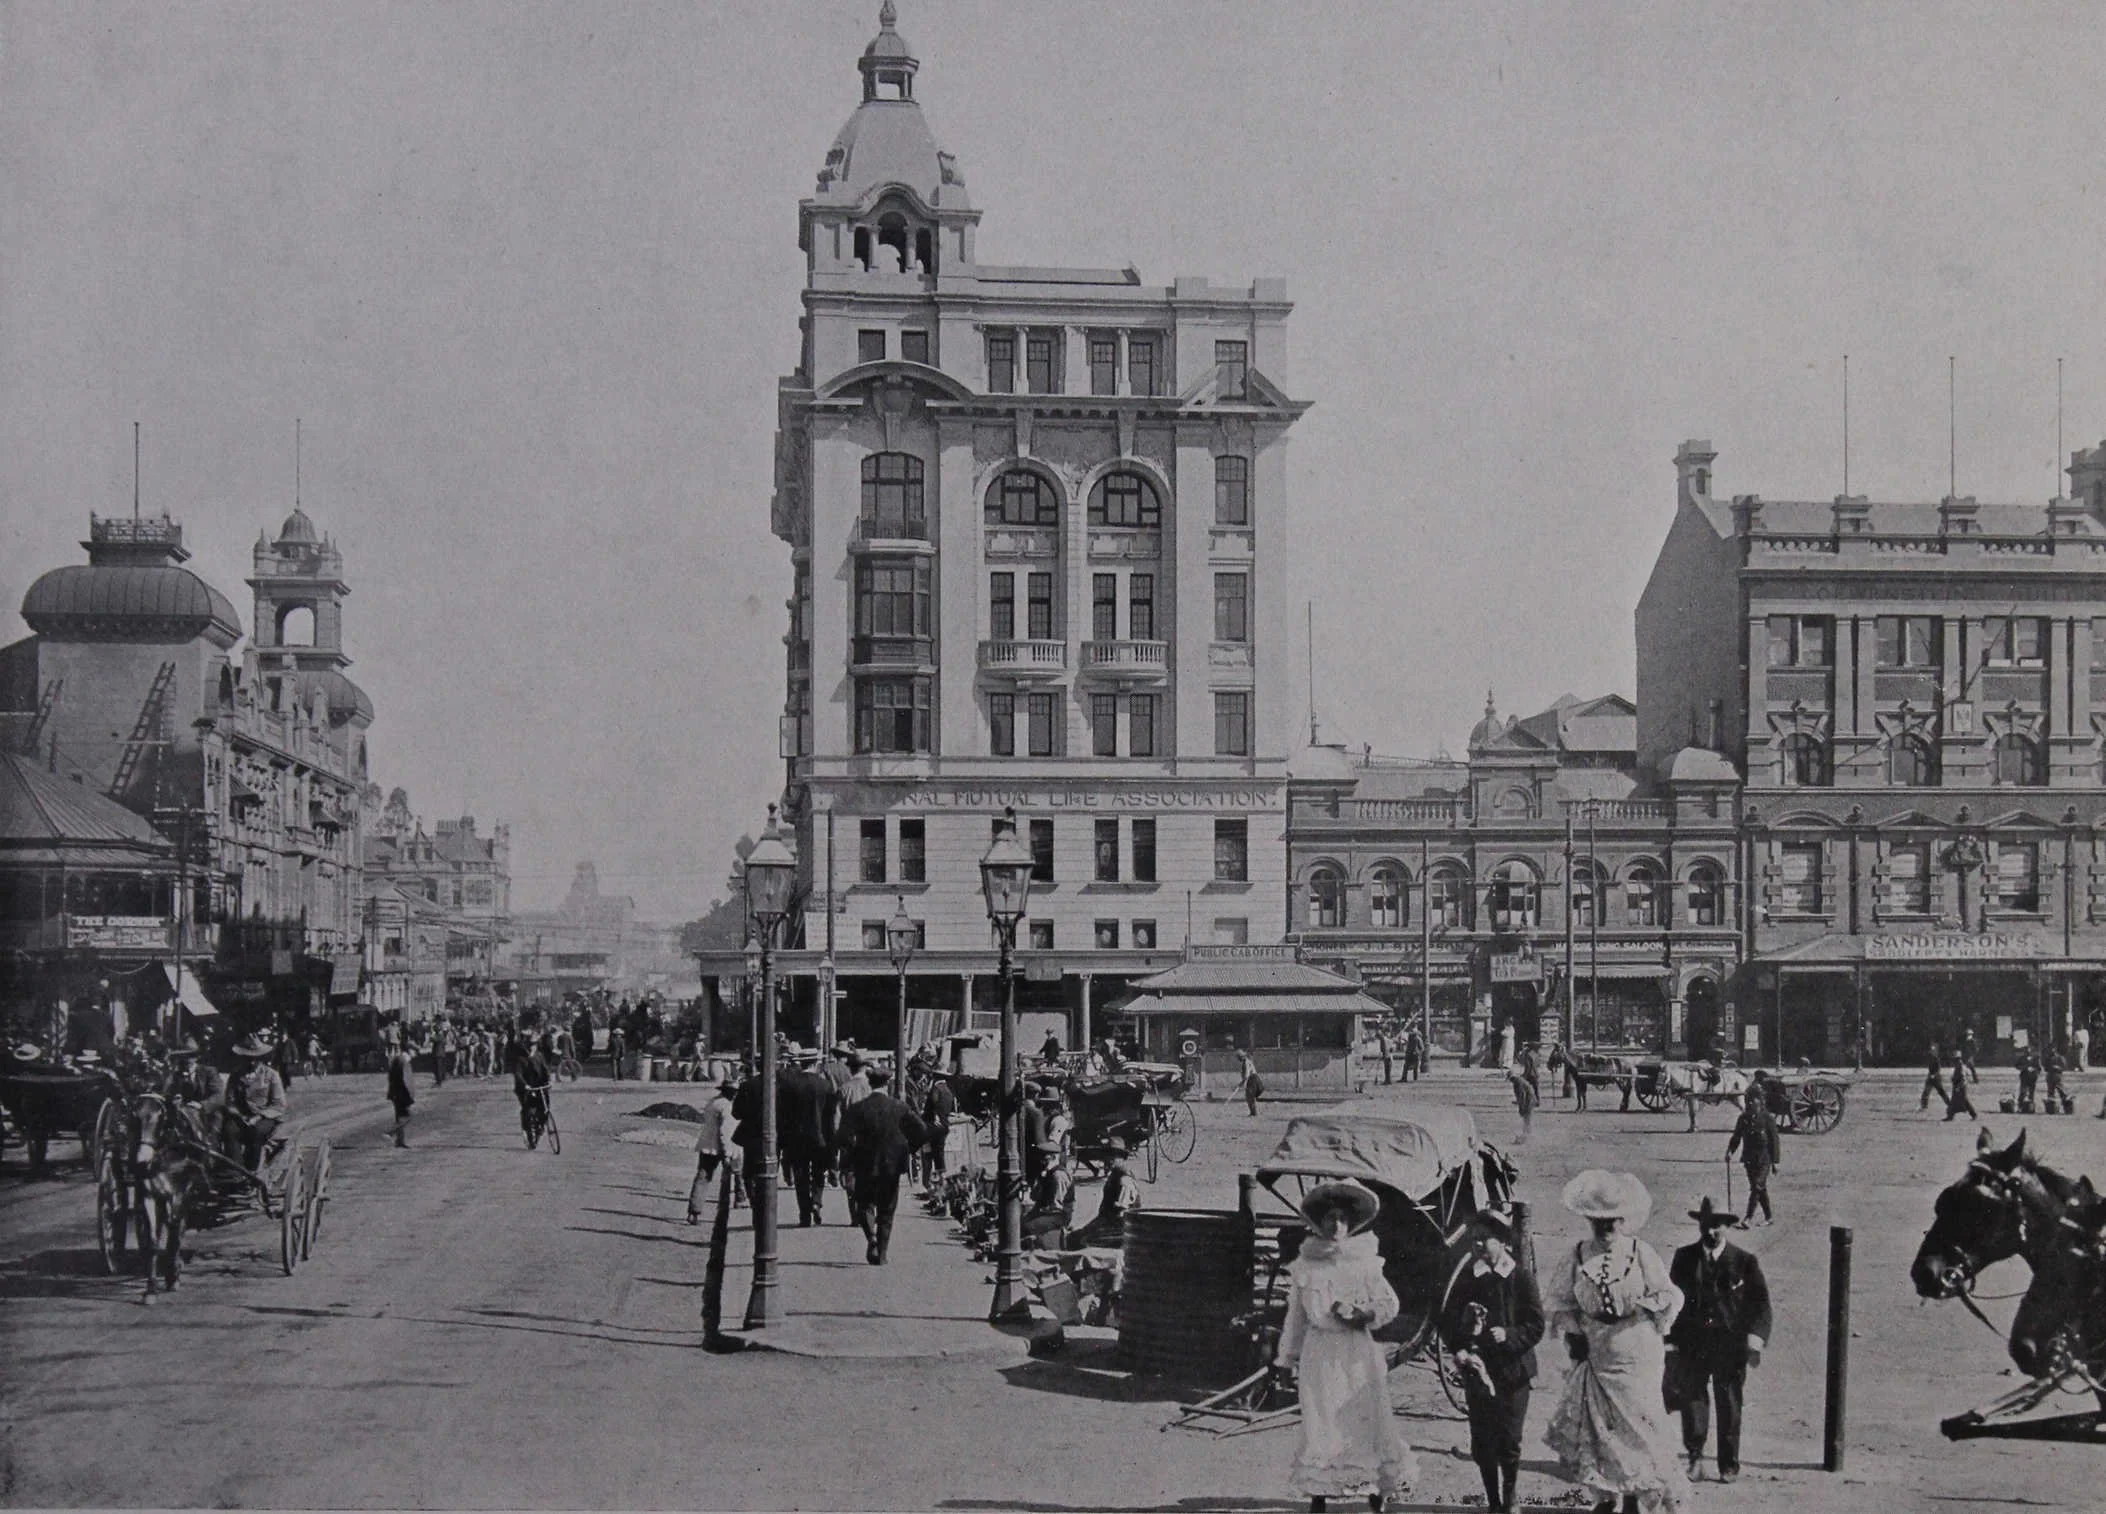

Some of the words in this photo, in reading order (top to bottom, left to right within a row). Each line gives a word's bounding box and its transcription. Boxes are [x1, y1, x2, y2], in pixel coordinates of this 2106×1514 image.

[953, 789, 1039, 807] MUTUAL
[1048, 789, 1098, 807] LIFE
[1193, 946, 1231, 958] PUBLIC
[1231, 946, 1253, 958] CAB
[1253, 946, 1285, 958] OFFICE
